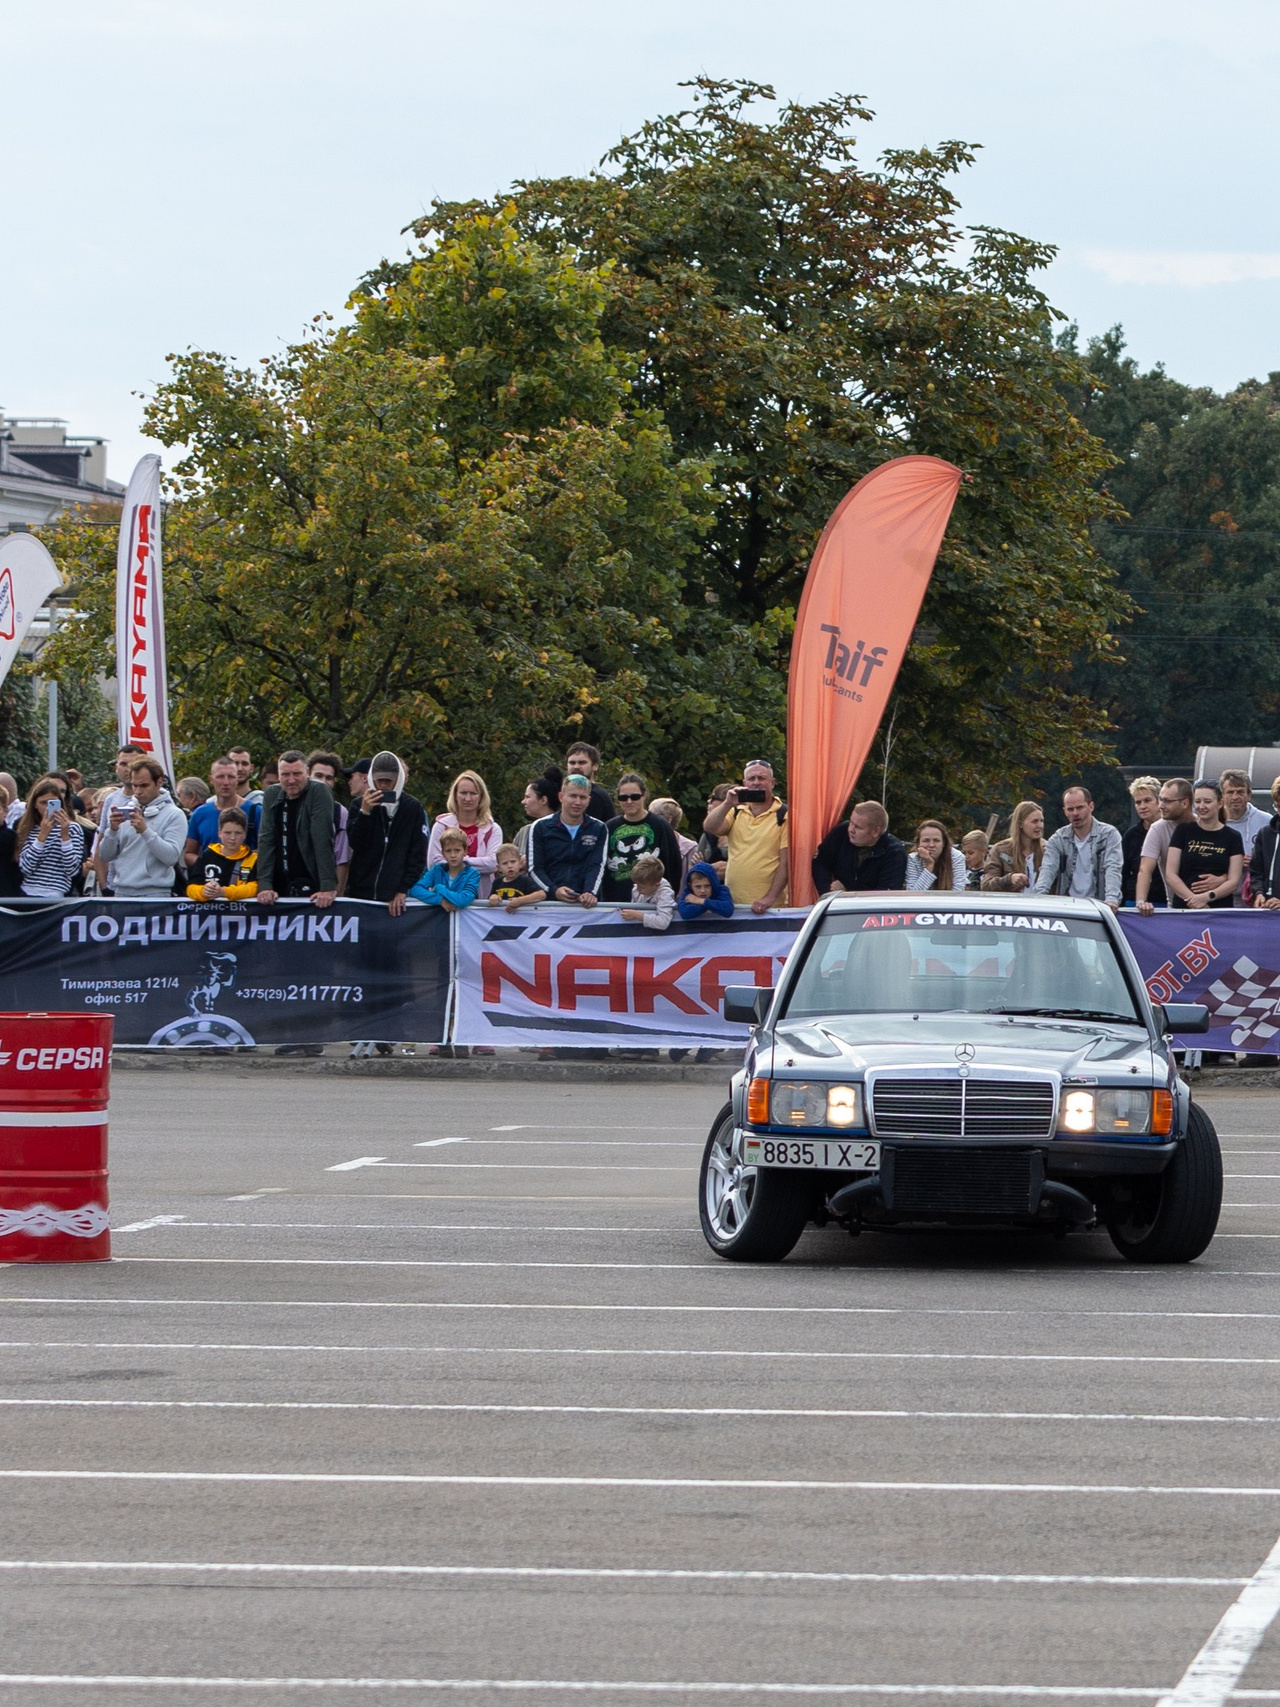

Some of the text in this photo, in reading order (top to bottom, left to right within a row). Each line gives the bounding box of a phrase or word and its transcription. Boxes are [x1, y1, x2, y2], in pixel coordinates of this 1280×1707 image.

[130, 504, 154, 753] KAYAMA
[820, 623, 888, 687] Taif
[177, 902, 247, 912] Ференс-ВК
[61, 915, 359, 946] ПОДШИПНИКИ
[1145, 928, 1221, 1005] DT.BY
[61, 977, 180, 991] Тимирязева 121/4
[235, 984, 363, 1003] +375(29)2117773
[481, 952, 787, 1016] NAKA
[85, 992, 147, 1005] офис 517
[16, 1047, 104, 1071] CEPSA
[747, 1153, 759, 1163] BY
[764, 1142, 815, 1165] 8835
